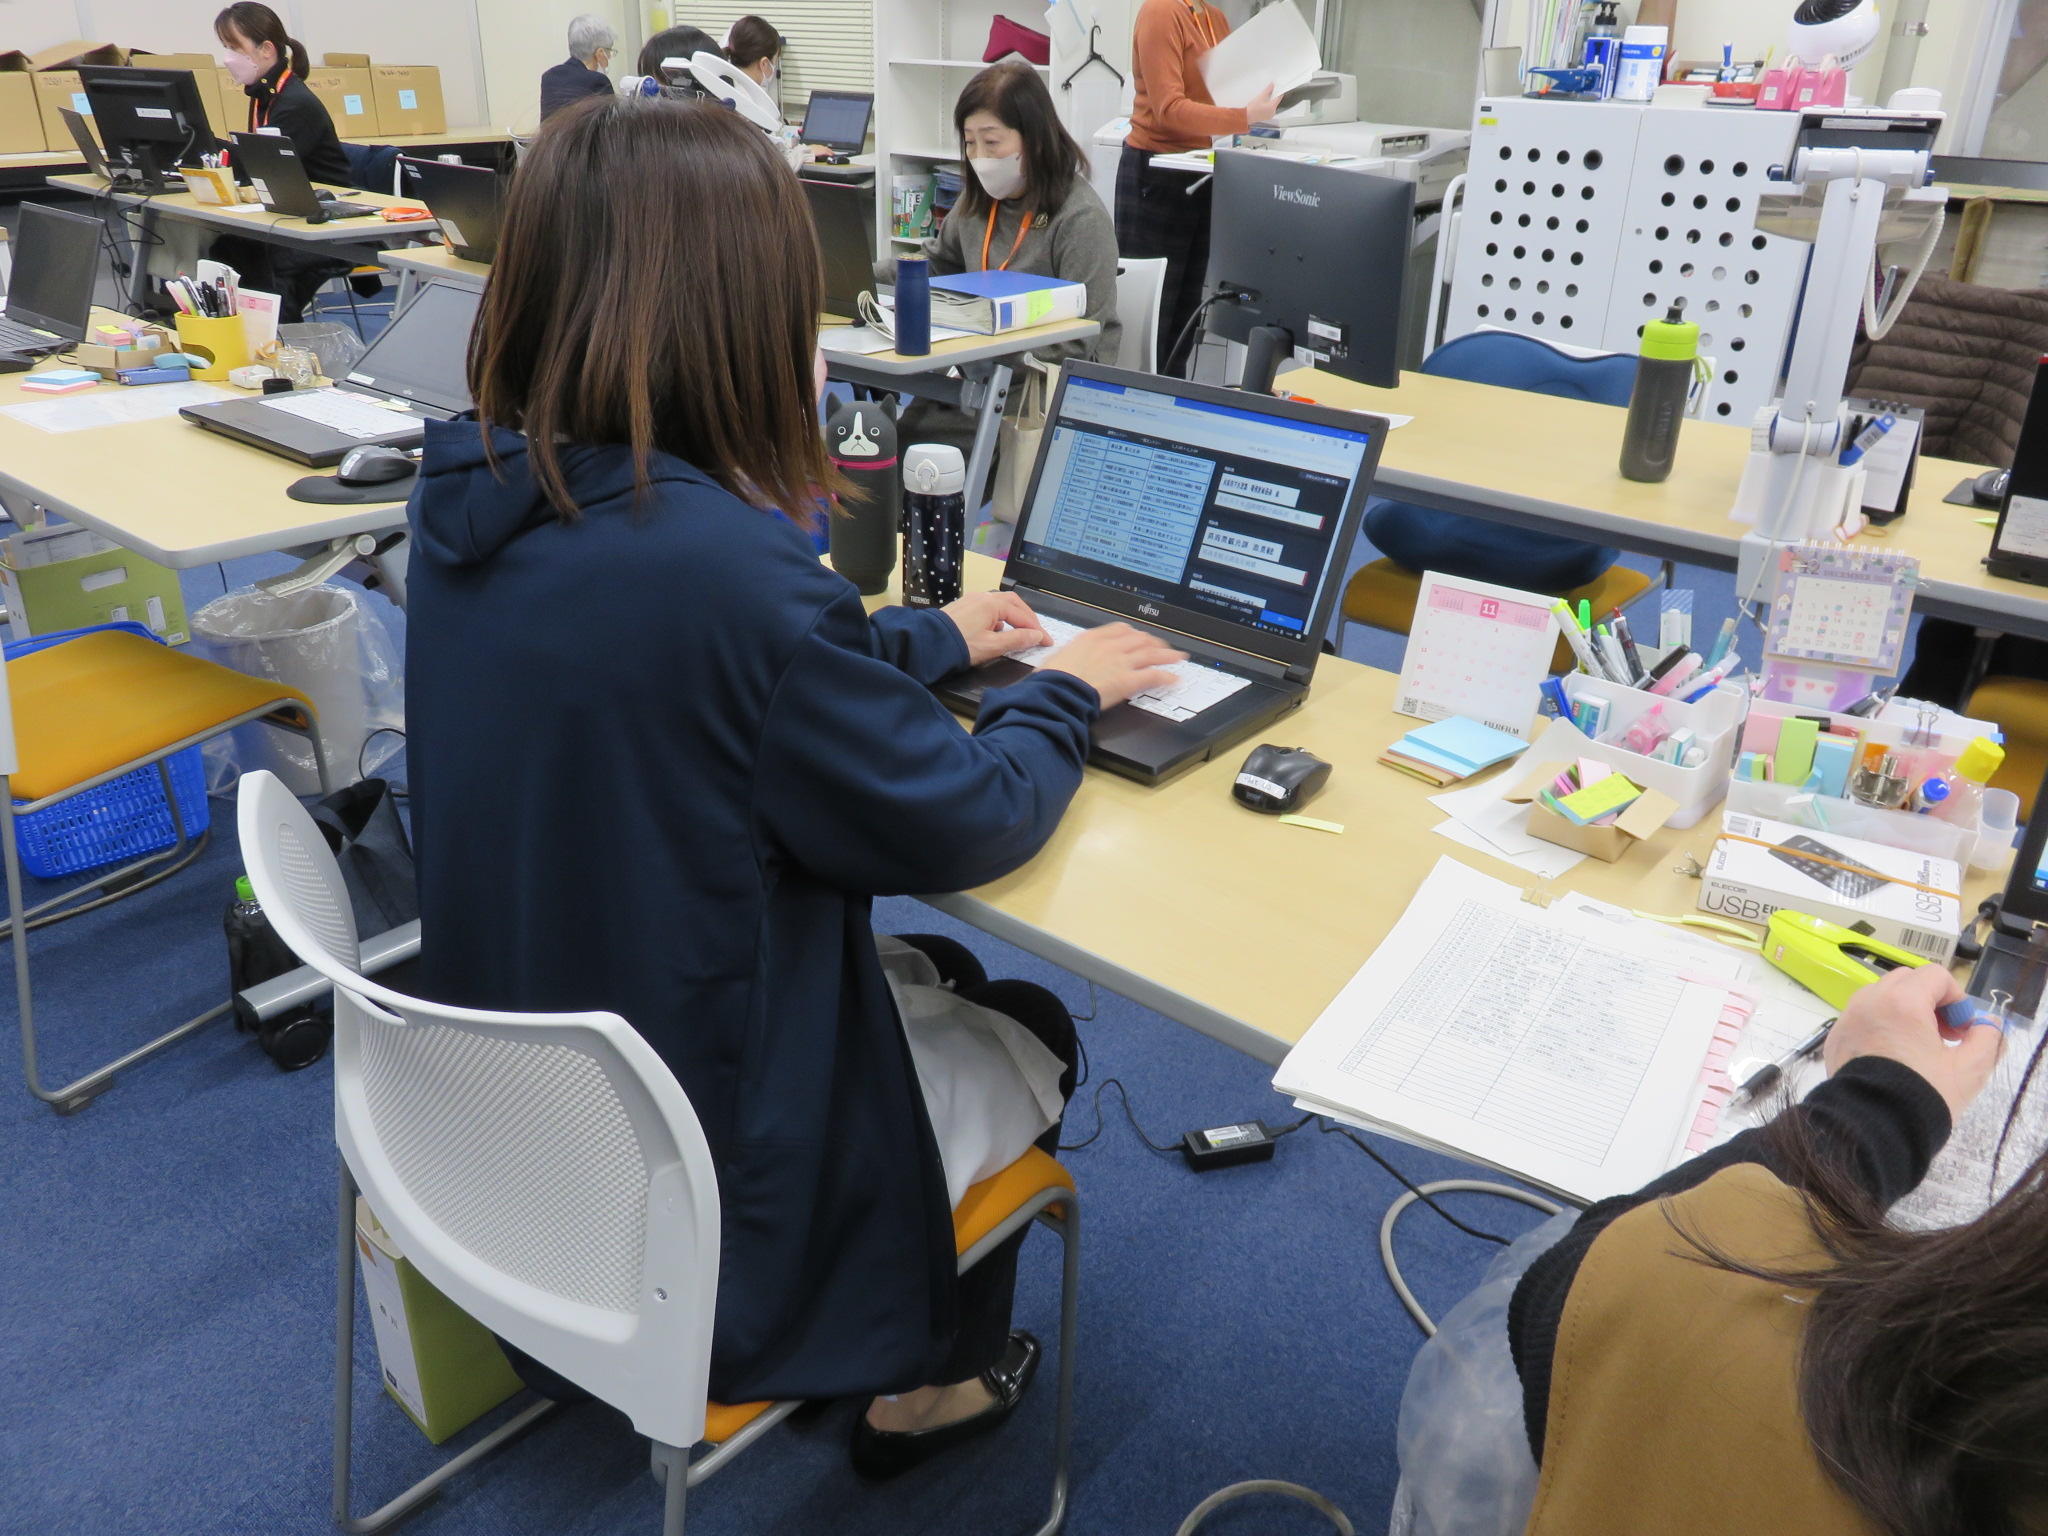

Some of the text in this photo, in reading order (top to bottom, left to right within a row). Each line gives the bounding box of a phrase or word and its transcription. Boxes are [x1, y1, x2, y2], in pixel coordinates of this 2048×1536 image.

[1272, 184, 1320, 207] ViewSonic
[1138, 602, 1160, 617] FUJITSU
[1482, 602, 1497, 615] 11
[1484, 720, 1519, 735] FUJIFILM
[1711, 881, 1747, 894] ELECOM
[1706, 891, 1760, 919] USB
[1915, 893, 1942, 922] USB
